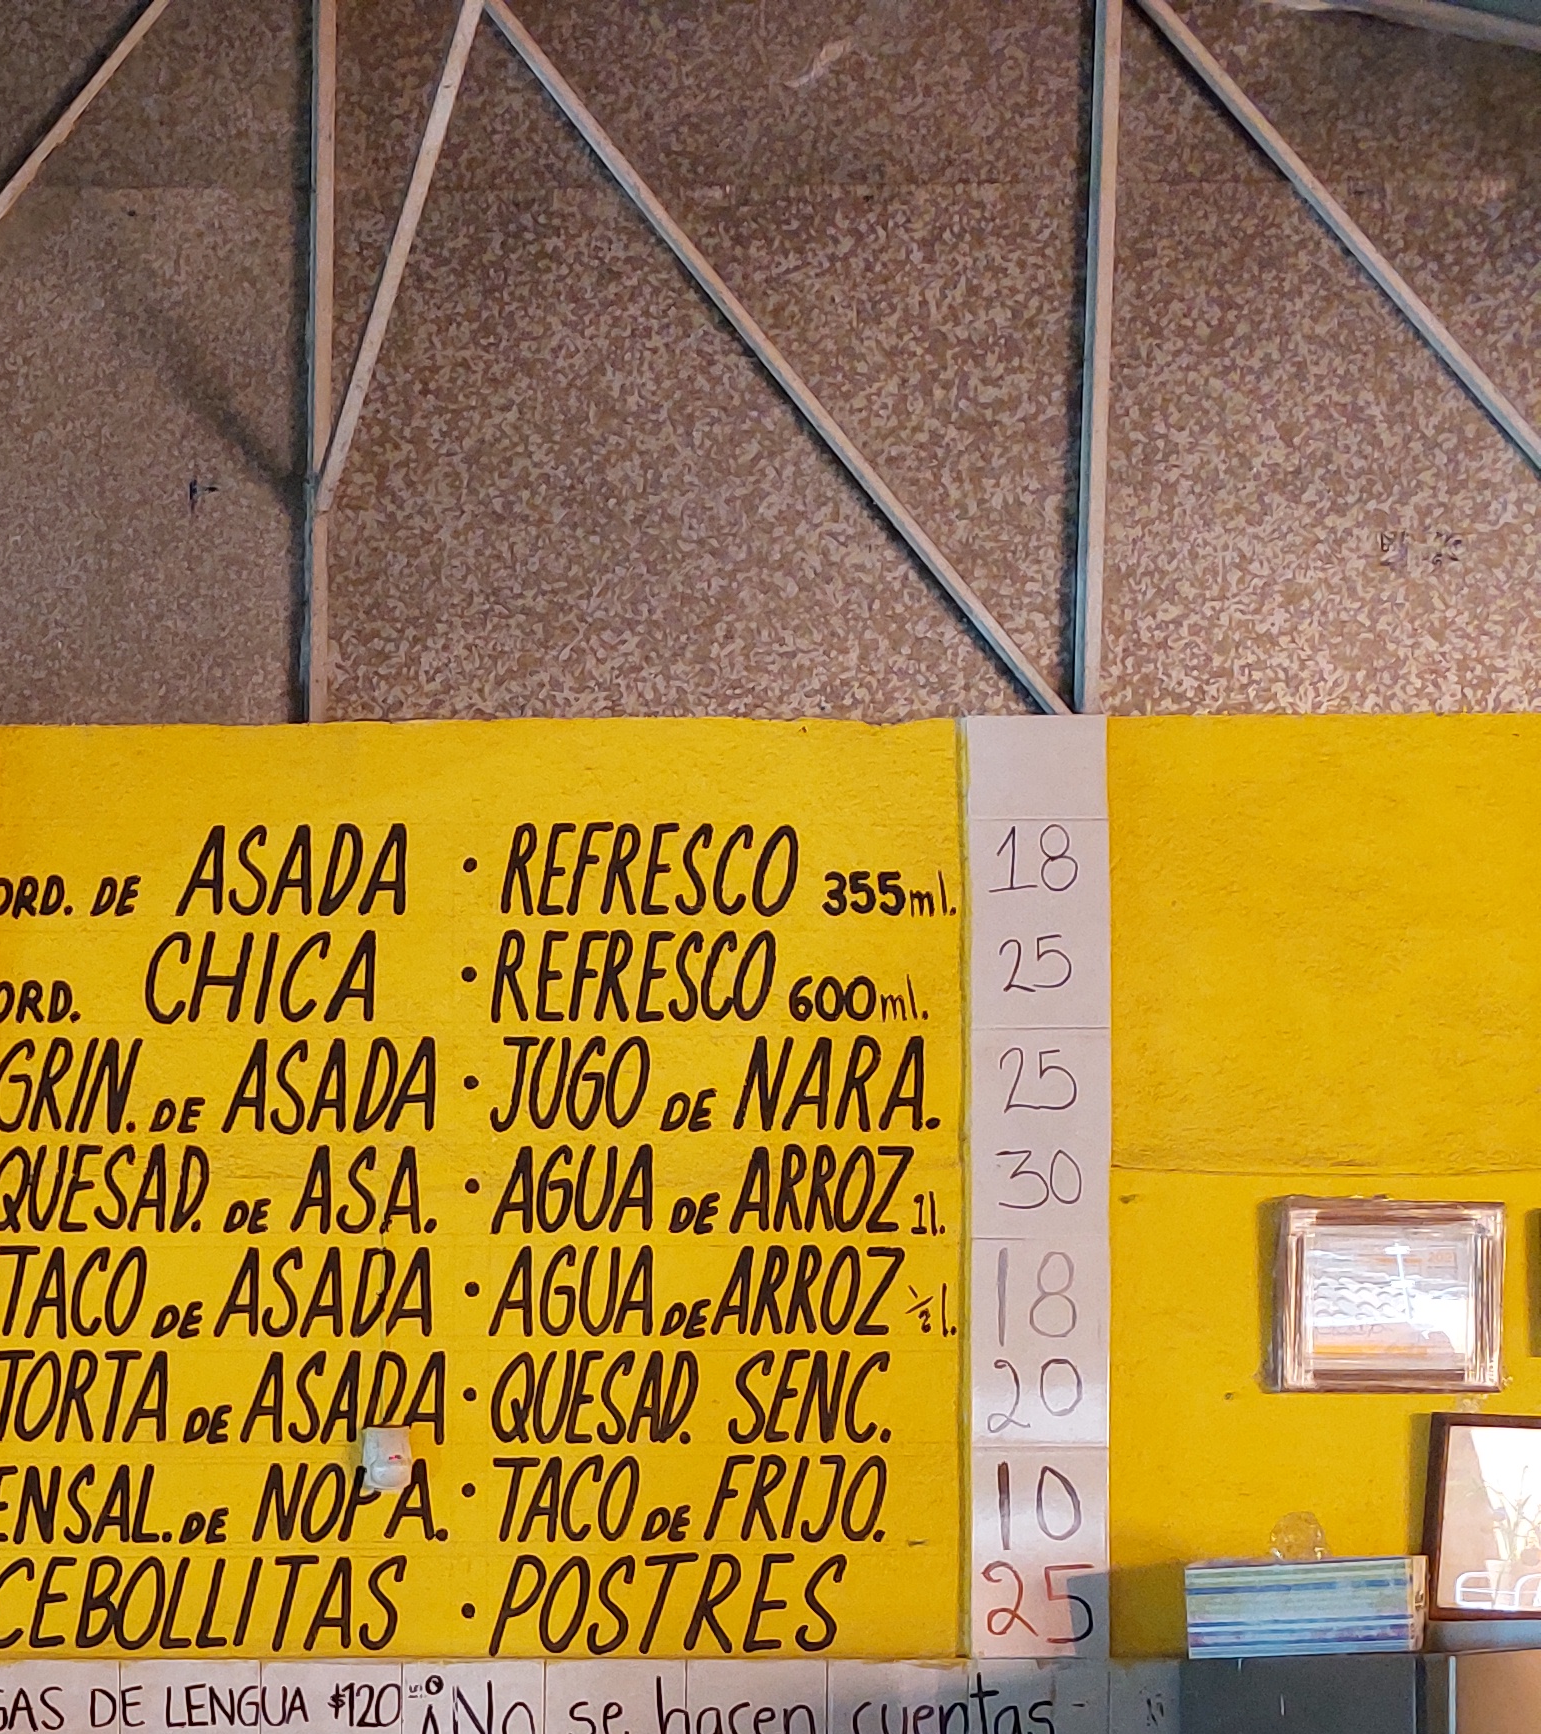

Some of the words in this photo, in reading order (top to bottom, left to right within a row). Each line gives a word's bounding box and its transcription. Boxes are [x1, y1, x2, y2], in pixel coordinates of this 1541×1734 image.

[90, 875, 141, 916] DE
[175, 823, 407, 916] ASADA
[501, 822, 798, 917] REFRESCO
[989, 824, 1078, 892] 18
[145, 930, 376, 1024] CHICA
[491, 929, 776, 1023] REFRESCO
[999, 934, 1071, 992] 25
[149, 1097, 205, 1133] DE
[221, 1036, 436, 1135] ASADA
[490, 1036, 650, 1132] JUGO
[660, 1088, 717, 1132] DE
[733, 1035, 940, 1132] NARA.
[1000, 1048, 1077, 1113] 25
[223, 1198, 271, 1234] DE
[290, 1145, 437, 1235] ASA.
[490, 1144, 653, 1234] AGUA
[668, 1192, 720, 1235] DE
[729, 1144, 914, 1234] ARROZ
[995, 1150, 1081, 1209] 30
[151, 1301, 203, 1339] DE
[214, 1247, 432, 1338] ASADA
[489, 1244, 653, 1337] AGUA
[660, 1299, 711, 1339] DE
[710, 1245, 905, 1336] ARROZ
[998, 1250, 1076, 1346] 18
[183, 1405, 232, 1444] DE
[240, 1350, 445, 1444] ASADA
[491, 1350, 699, 1444] QUESAD.
[728, 1349, 891, 1444] SENC.
[988, 1359, 1082, 1432] 20
[179, 1507, 229, 1544] DE
[493, 1454, 639, 1542] TACO
[641, 1505, 690, 1542] DE
[703, 1454, 887, 1542] FRIJO.
[998, 1461, 1081, 1550] 10
[489, 1553, 847, 1658] POSTRES
[982, 1563, 1099, 1643] 25
[90, 1681, 145, 1727] DE
[166, 1684, 309, 1732] LENGUA
